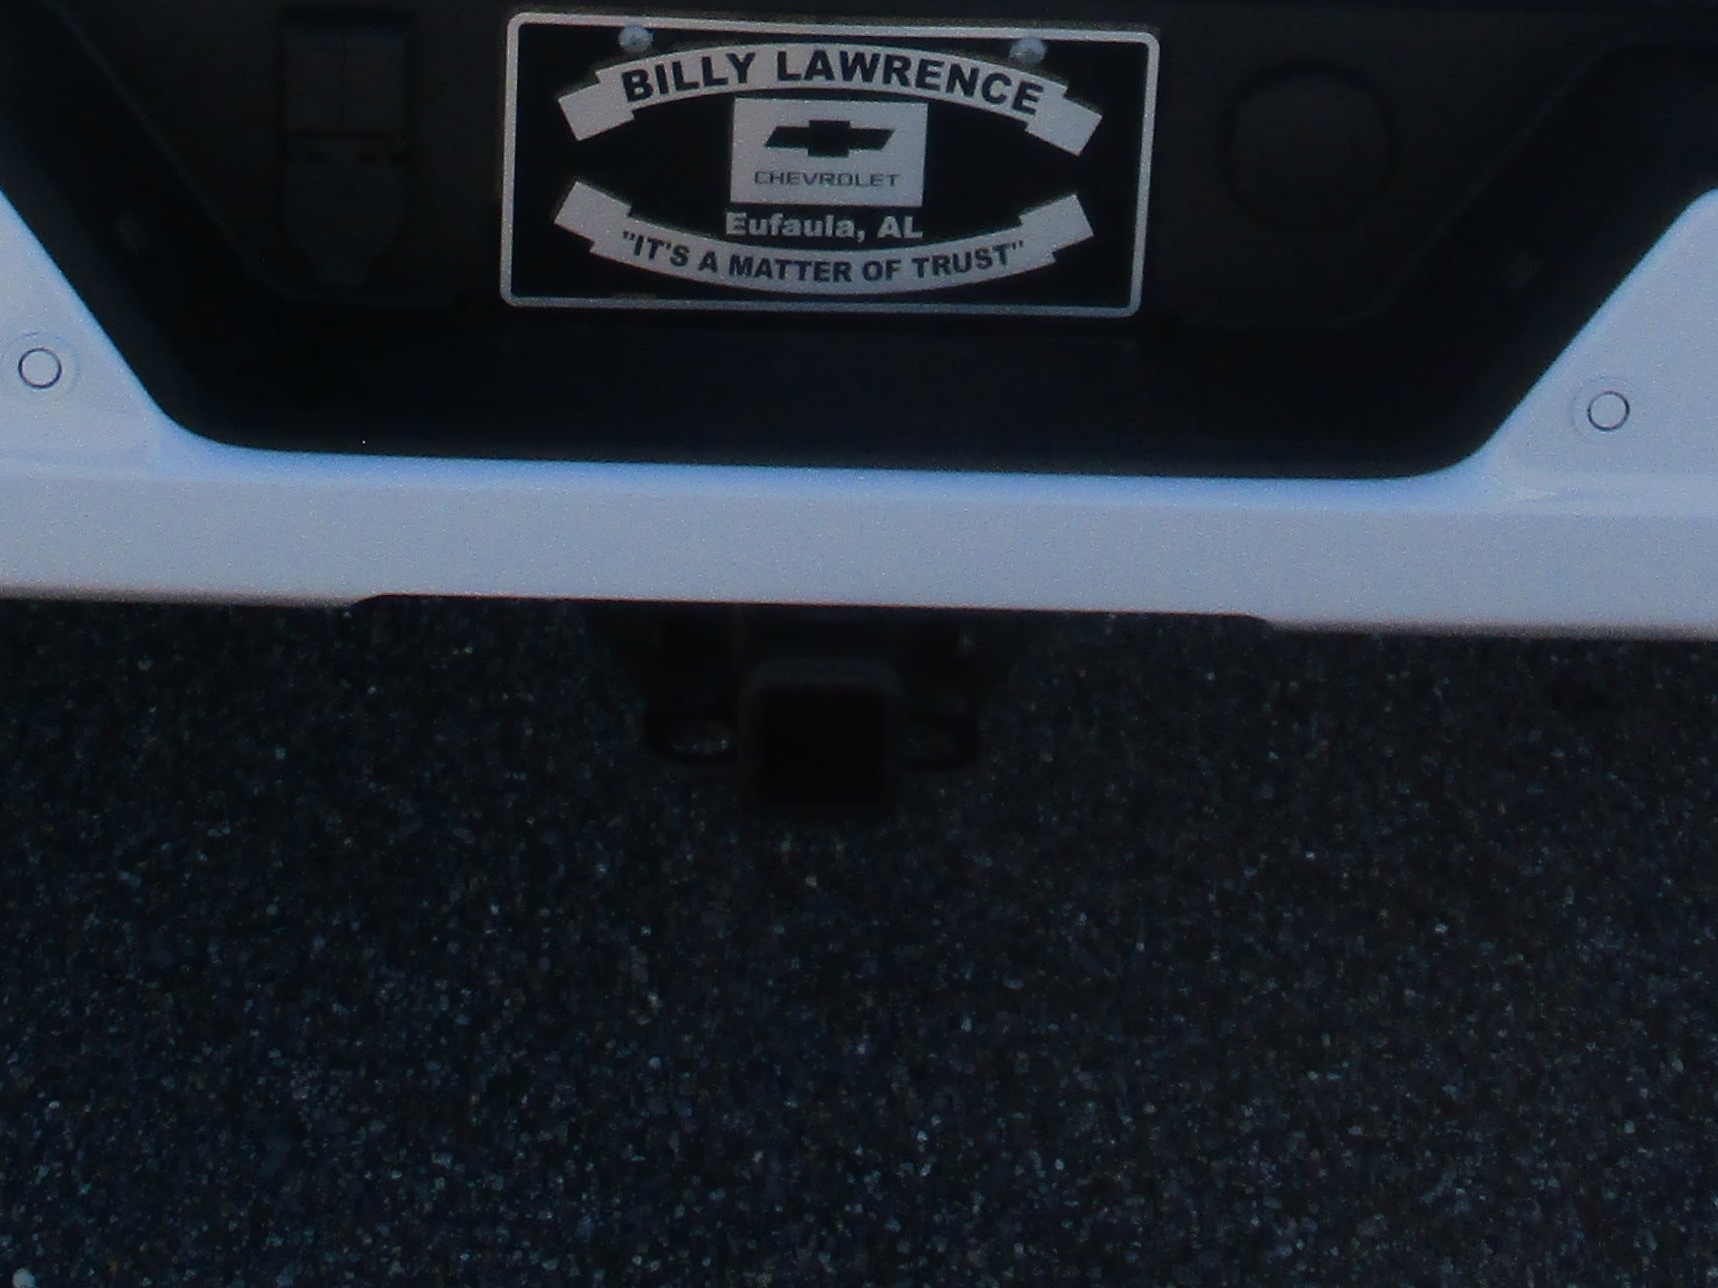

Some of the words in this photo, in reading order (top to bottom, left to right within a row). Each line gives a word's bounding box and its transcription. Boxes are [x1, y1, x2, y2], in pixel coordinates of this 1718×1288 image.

[621, 51, 757, 103] BILLY
[776, 49, 1044, 115] LAWRENCE
[753, 170, 900, 188] CHEVROLET
[725, 211, 865, 242] Eufaula,
[877, 214, 923, 240] AL
[622, 230, 690, 267] "IT'S
[698, 250, 719, 273] A
[728, 255, 852, 283] MATTER
[862, 258, 901, 282] OF
[911, 239, 1025, 278] TRUST"
